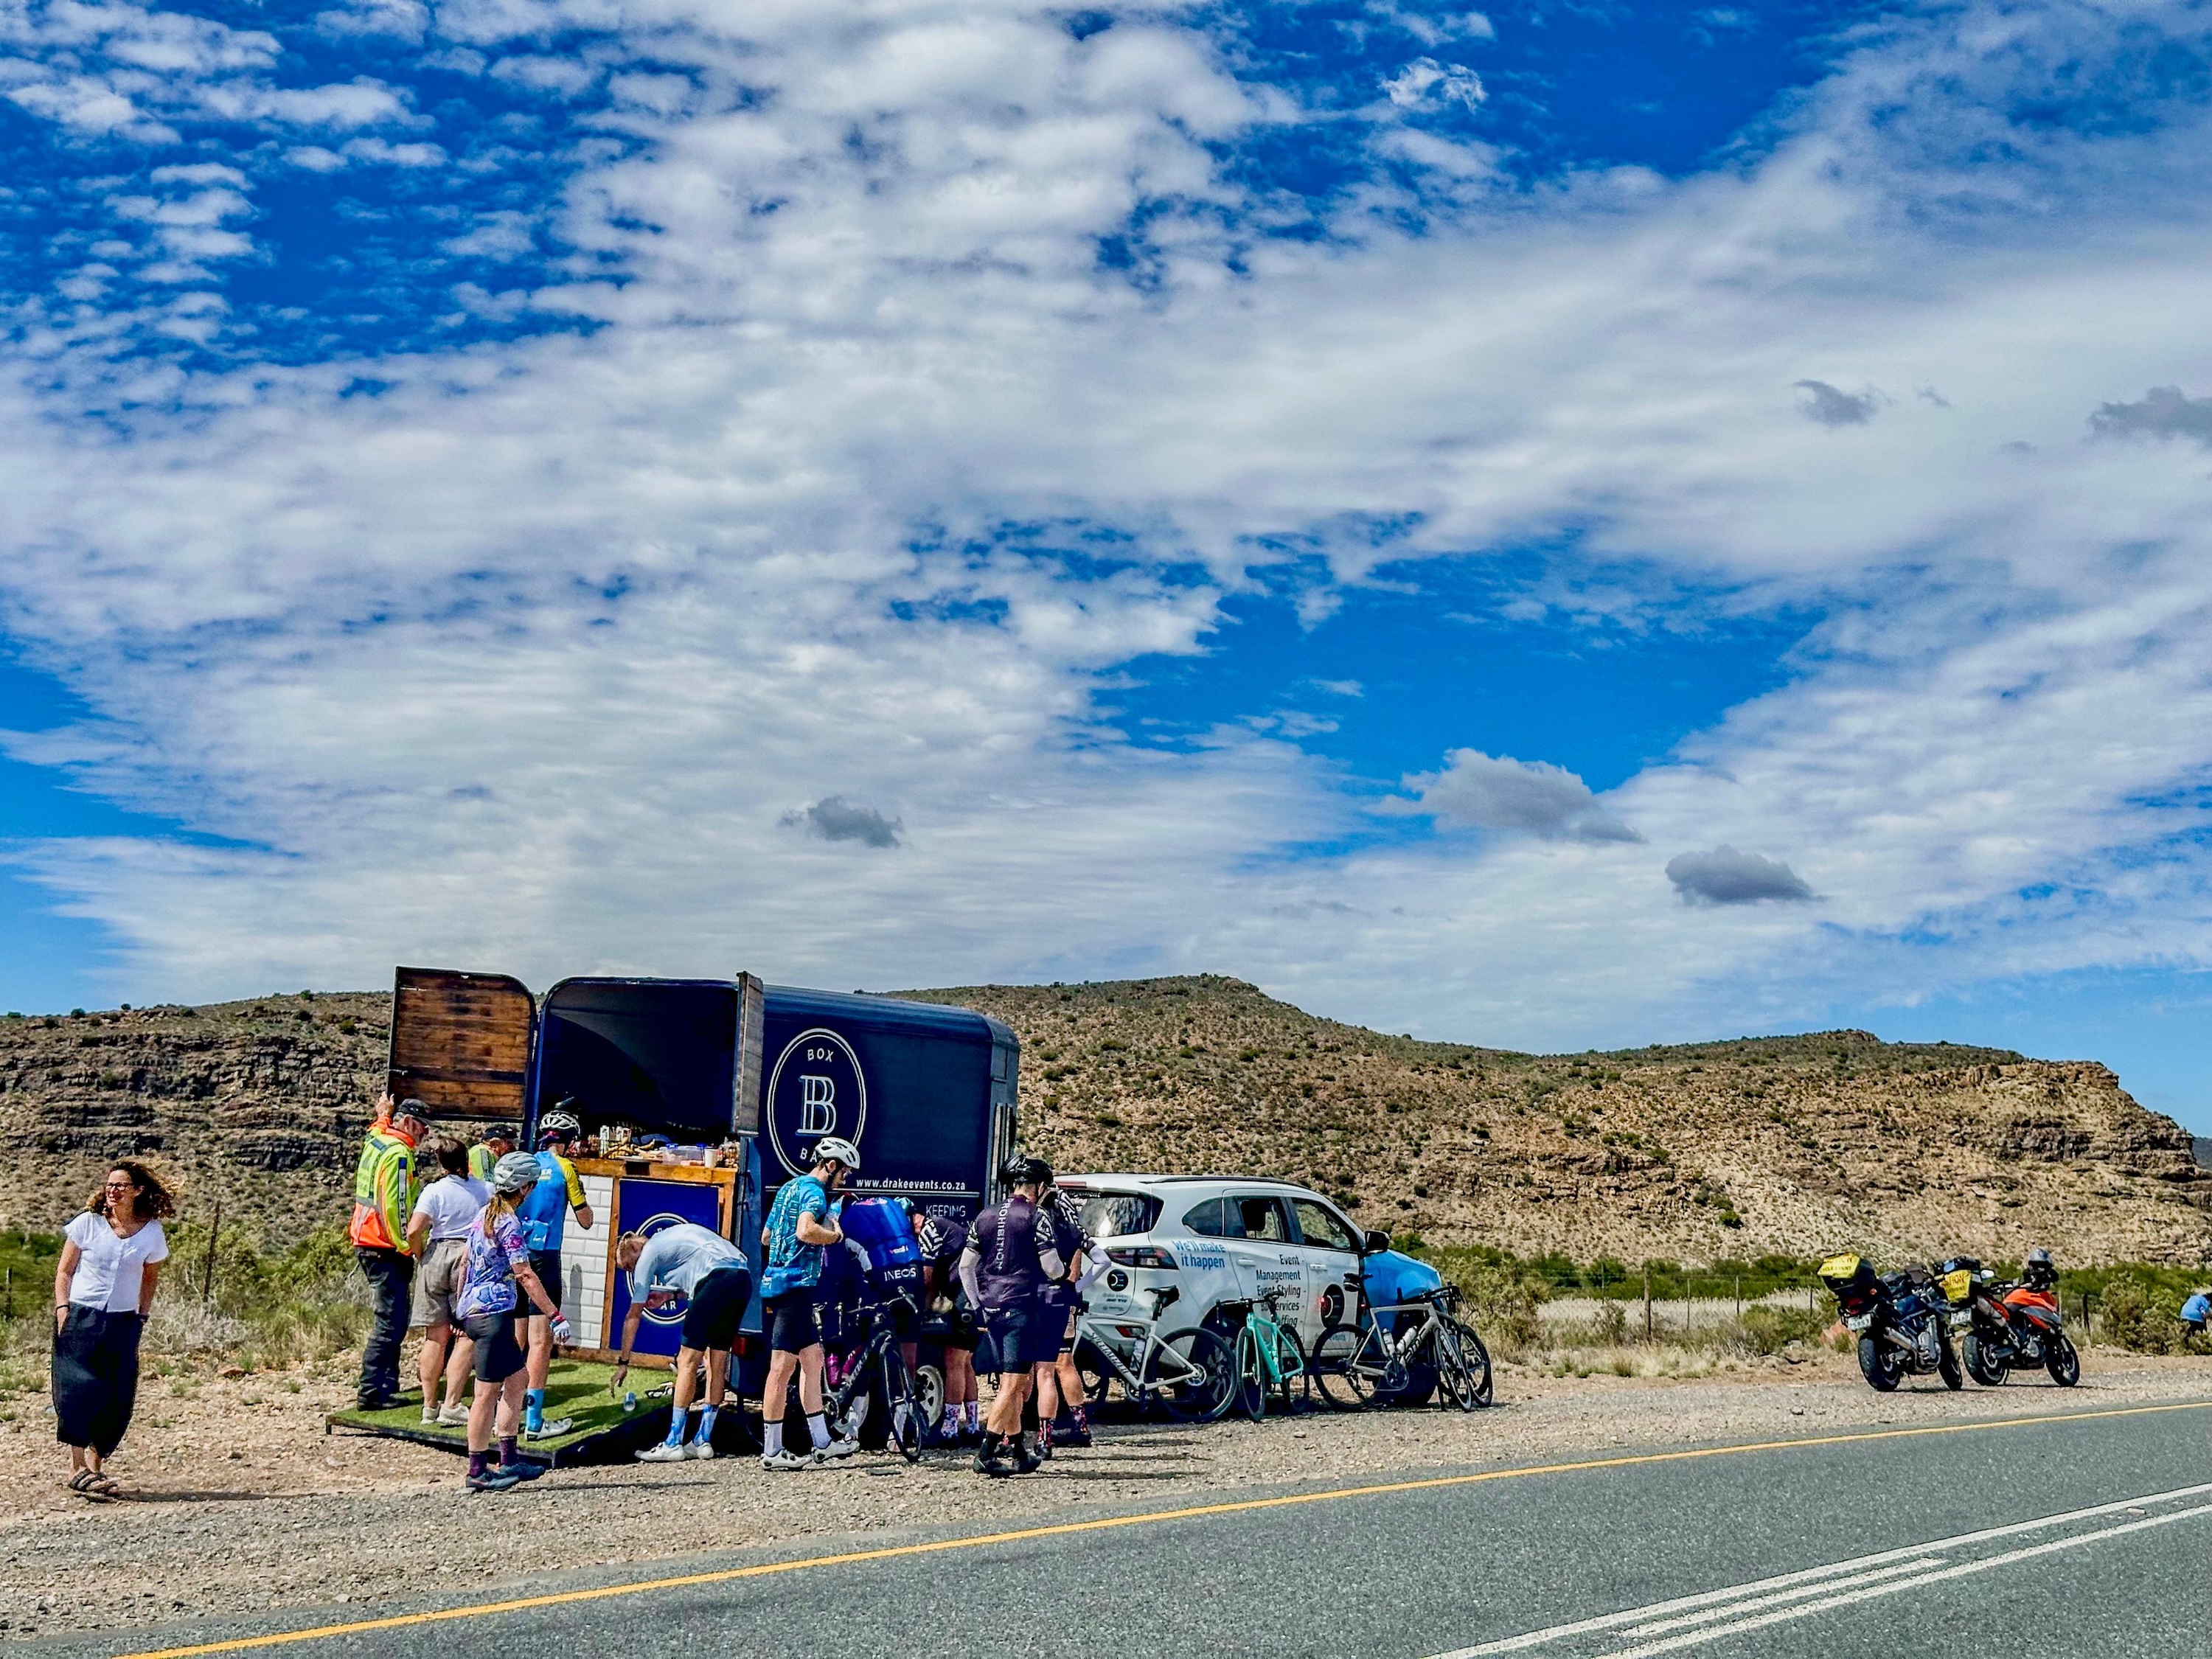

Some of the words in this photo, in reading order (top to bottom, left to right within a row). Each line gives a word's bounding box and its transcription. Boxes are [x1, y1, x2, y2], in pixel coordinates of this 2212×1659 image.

[807, 1048, 834, 1062] BOX
[799, 1147, 818, 1163] BA
[856, 1178, 966, 1191] www.drakeevents.co.za
[925, 1204, 967, 1218] KEEPING
[995, 1197, 1015, 1271] PROHIBITION
[1172, 1240, 1200, 1252] We'll
[1200, 1242, 1226, 1253] make
[1180, 1253, 1189, 1267] it
[1190, 1253, 1225, 1270] happen
[1279, 1254, 1300, 1265] Event
[884, 1267, 917, 1282] INEOS
[1256, 1269, 1301, 1283] Management
[1275, 1300, 1300, 1312] ervices
[1276, 1314, 1298, 1328] affing
